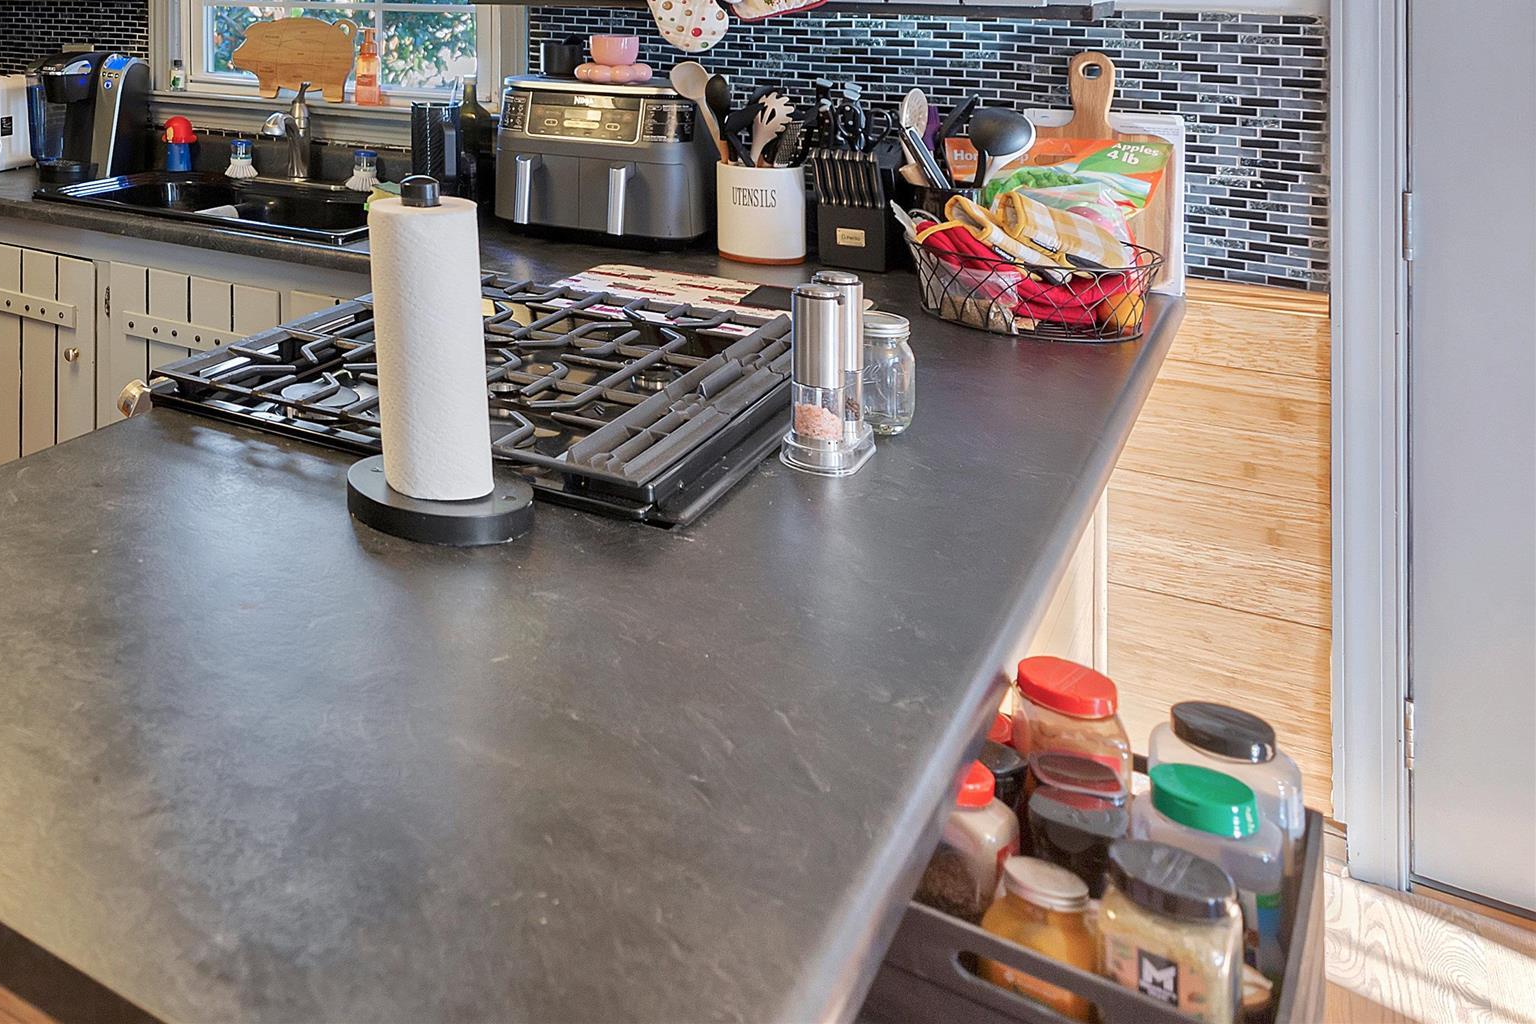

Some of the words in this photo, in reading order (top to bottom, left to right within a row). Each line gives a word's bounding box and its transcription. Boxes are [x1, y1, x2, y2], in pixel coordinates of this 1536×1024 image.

[1112, 142, 1161, 158] Apples
[1106, 151, 1119, 161] 4
[1122, 152, 1140, 166] lb
[732, 186, 777, 209] UTENSILS
